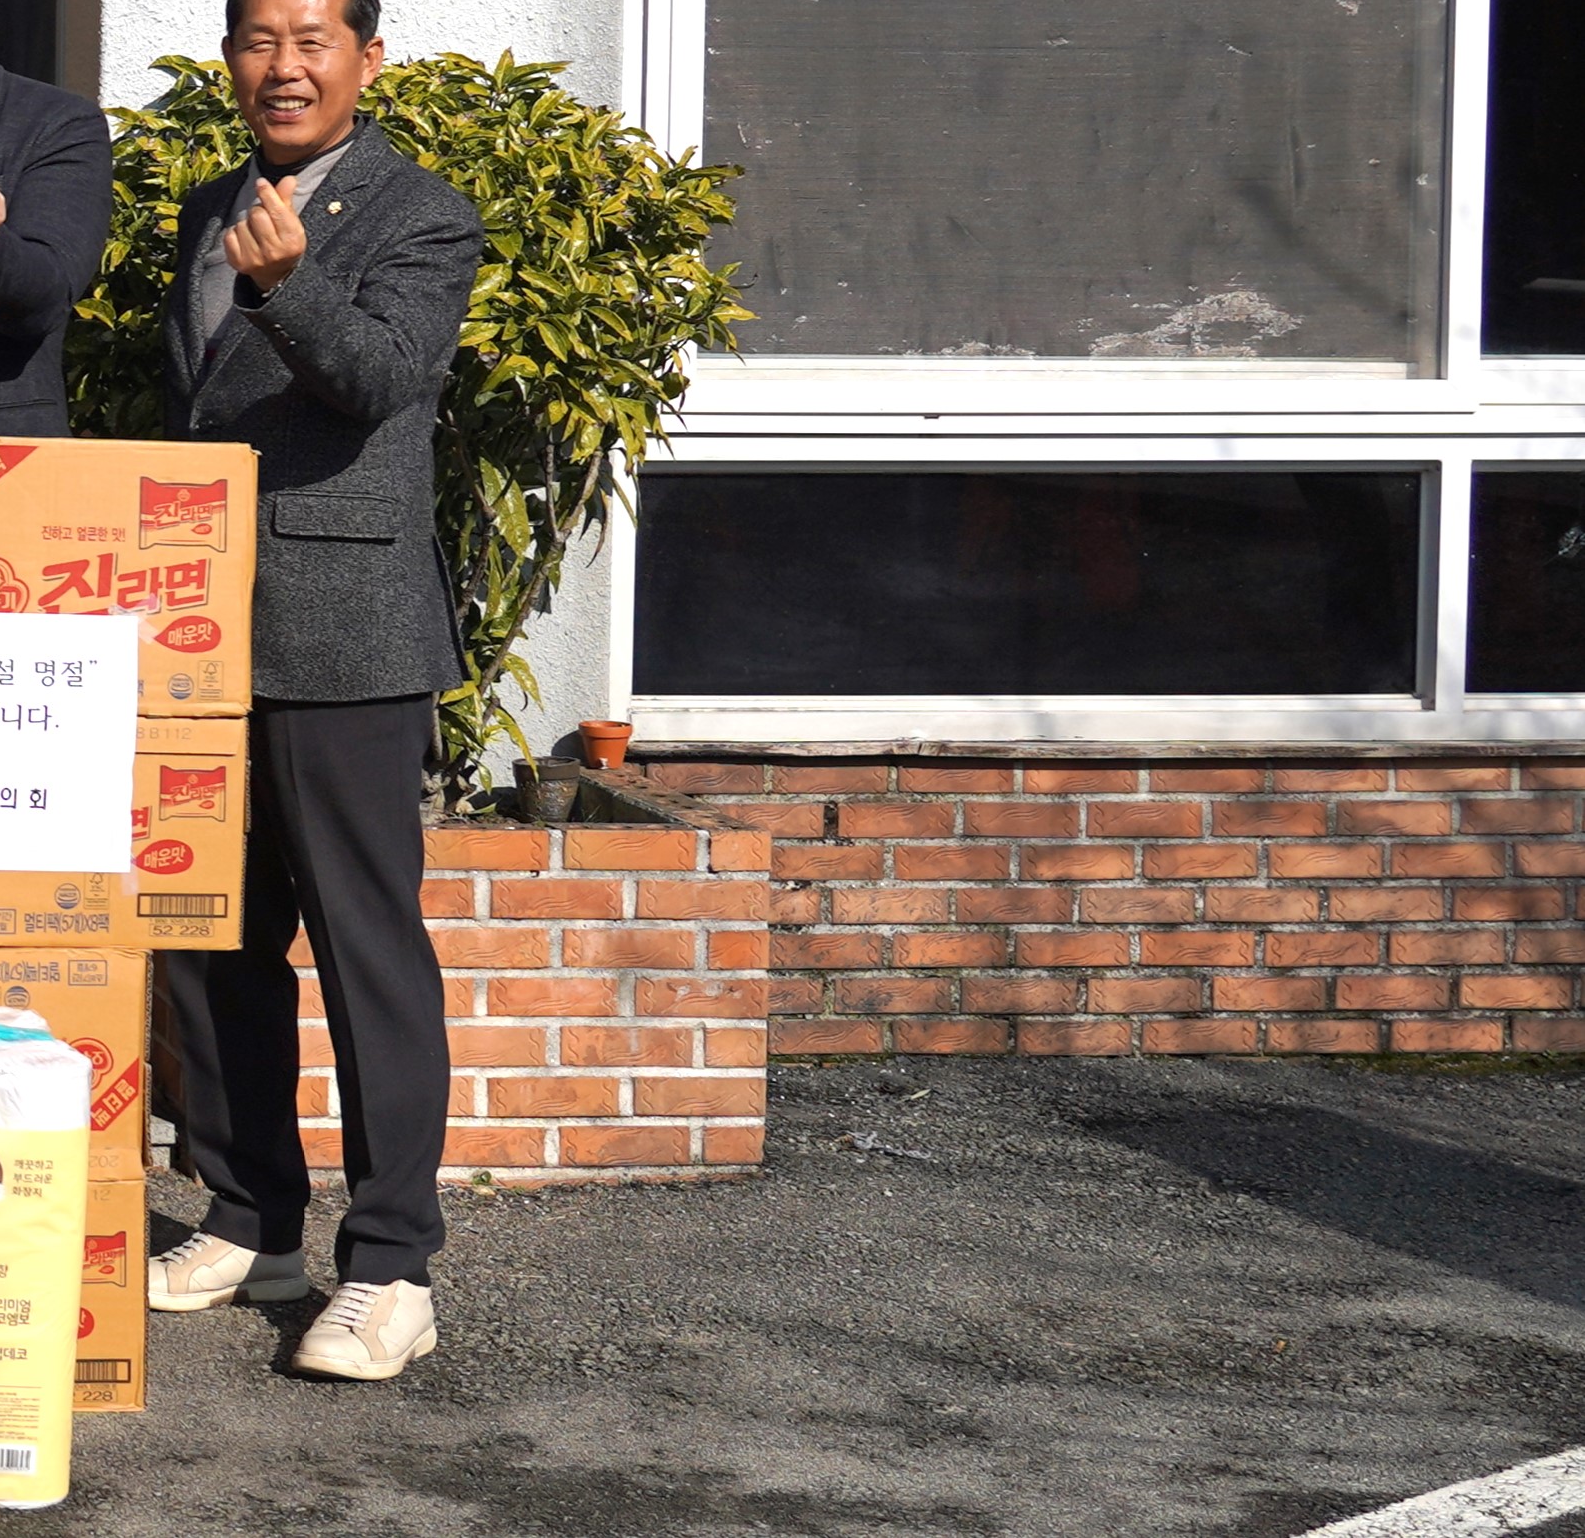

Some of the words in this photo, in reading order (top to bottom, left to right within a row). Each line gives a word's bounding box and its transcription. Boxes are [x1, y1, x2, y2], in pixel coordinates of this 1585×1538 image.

[41, 526, 72, 541] 진하고
[77, 526, 108, 542] 얼큰한
[111, 527, 126, 543] 맛!
[37, 552, 207, 615] 진라면
[167, 622, 214, 646] 매운맛
[143, 845, 186, 868] 매운맛
[152, 924, 175, 937] 52
[179, 924, 211, 937] 228
[81, 1391, 113, 1402] 228
